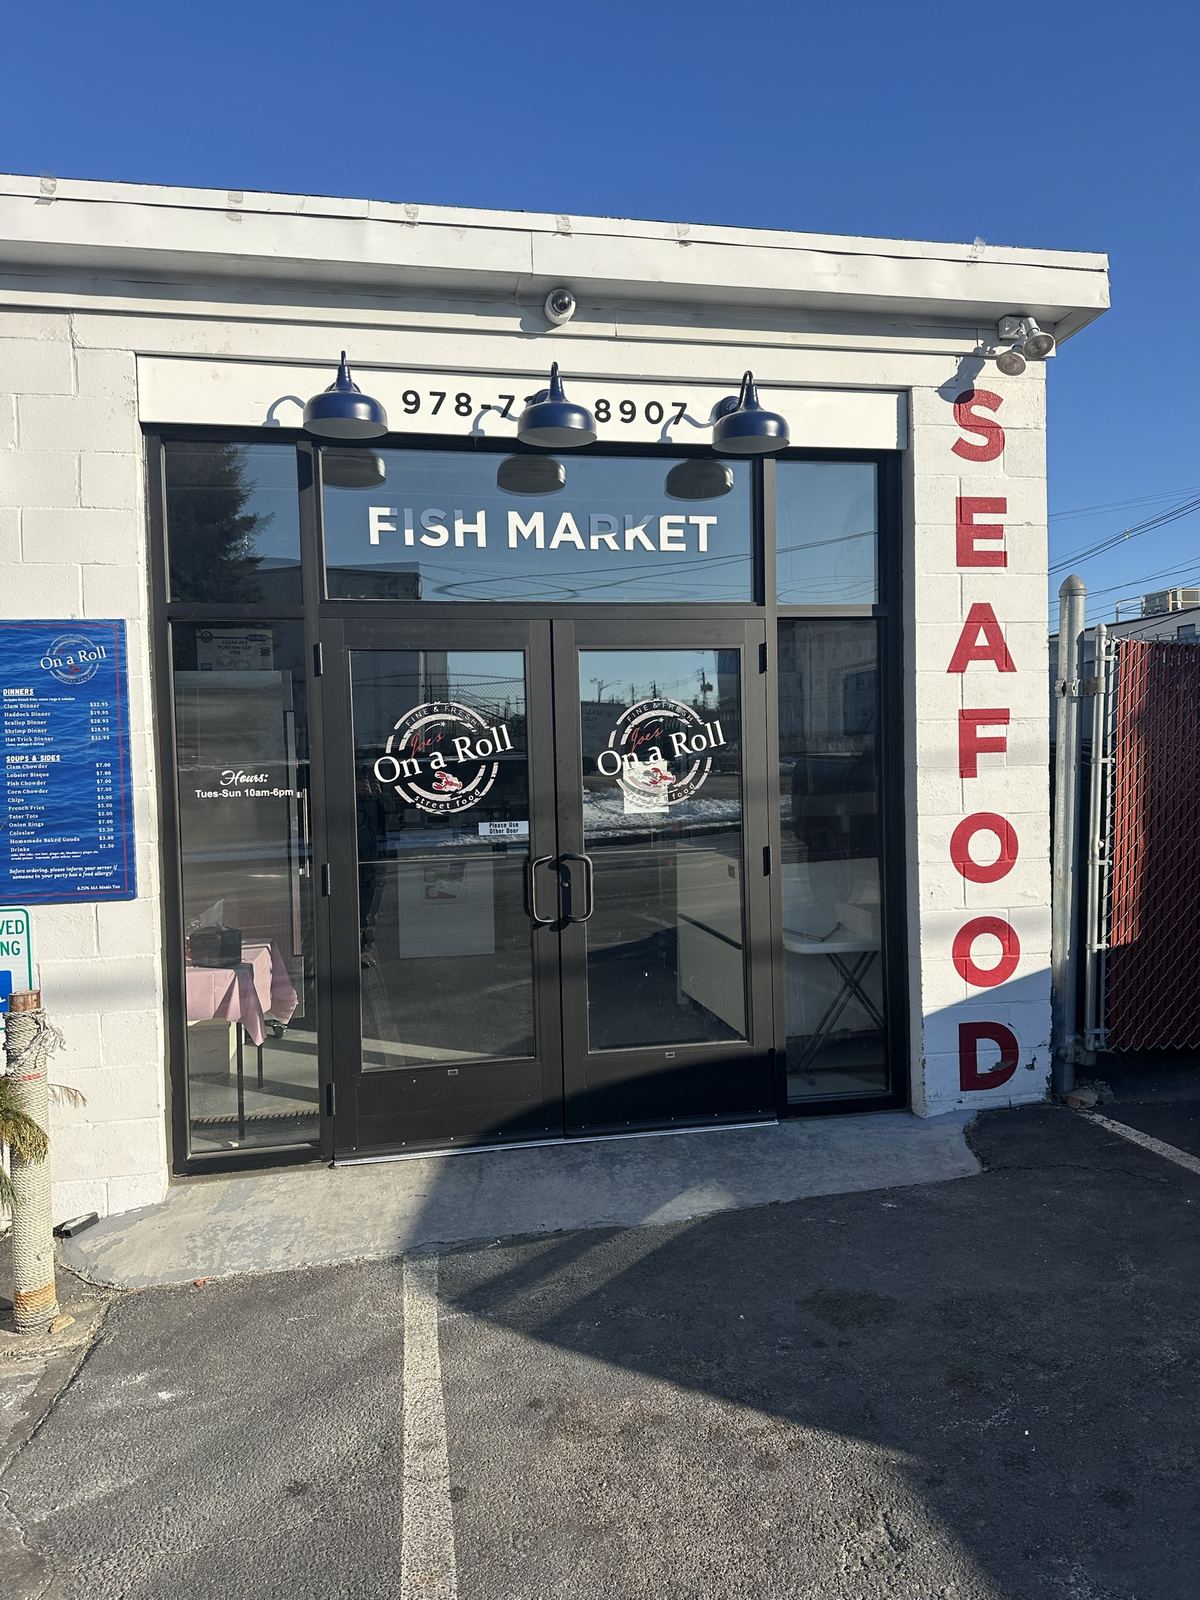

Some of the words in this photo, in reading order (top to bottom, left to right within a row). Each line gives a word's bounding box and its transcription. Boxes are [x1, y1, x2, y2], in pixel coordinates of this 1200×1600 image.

[401, 389, 688, 426] 978-78907
[368, 506, 487, 548] FISH
[507, 510, 719, 553] MARKET
[40, 655, 63, 670] On
[66, 655, 75, 665] a
[77, 645, 107, 663] Roll
[3, 688, 34, 696] DINNERS
[405, 708, 429, 727] FINE
[444, 705, 478, 726] FRESH
[626, 704, 649, 723] FINE
[597, 749, 641, 776] On
[648, 745, 665, 764] a
[669, 720, 727, 758] Roll
[946, 388, 1020, 1092] SEAFOOD
[373, 755, 423, 783] On
[429, 751, 447, 770] a
[452, 723, 515, 764] Roll
[219, 769, 269, 786] Hours:
[195, 789, 241, 798] Tues-Sun
[244, 787, 294, 798] 10am-6pm
[414, 795, 450, 810] street
[455, 788, 481, 808] food
